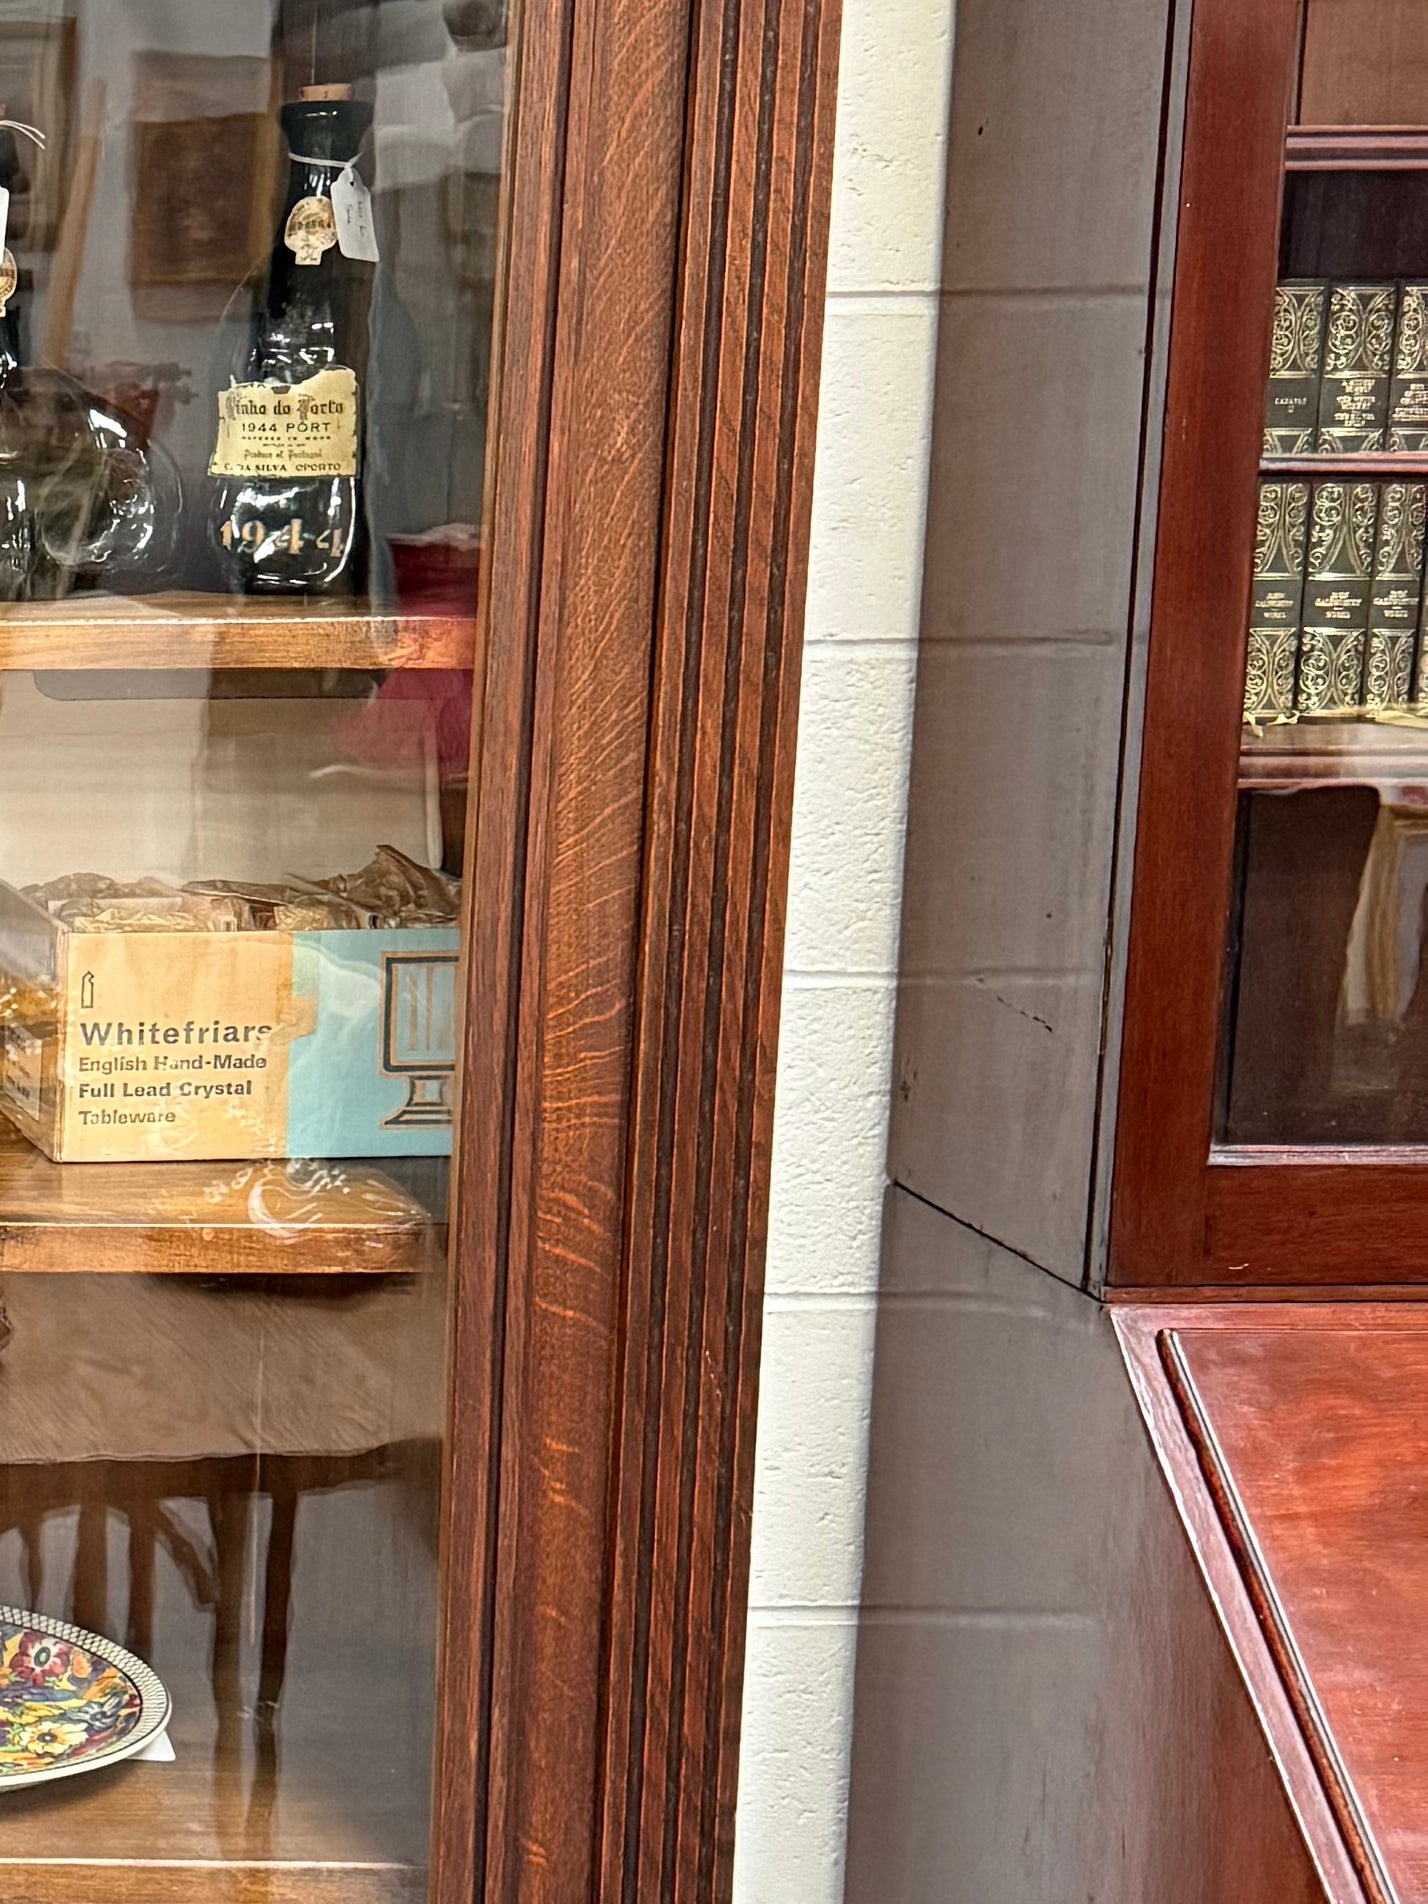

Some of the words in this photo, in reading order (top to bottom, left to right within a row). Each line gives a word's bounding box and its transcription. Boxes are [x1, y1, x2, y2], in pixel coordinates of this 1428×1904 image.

[242, 422, 278, 433] 1944
[285, 422, 332, 433] PORT
[80, 1019, 273, 1046] Whitefriars
[78, 1056, 147, 1075] English
[153, 1054, 267, 1071] Hand-Made
[79, 1082, 115, 1098] Full
[123, 1082, 171, 1097] Lead
[179, 1080, 252, 1099] Crystal
[79, 1109, 176, 1125] Tableware
